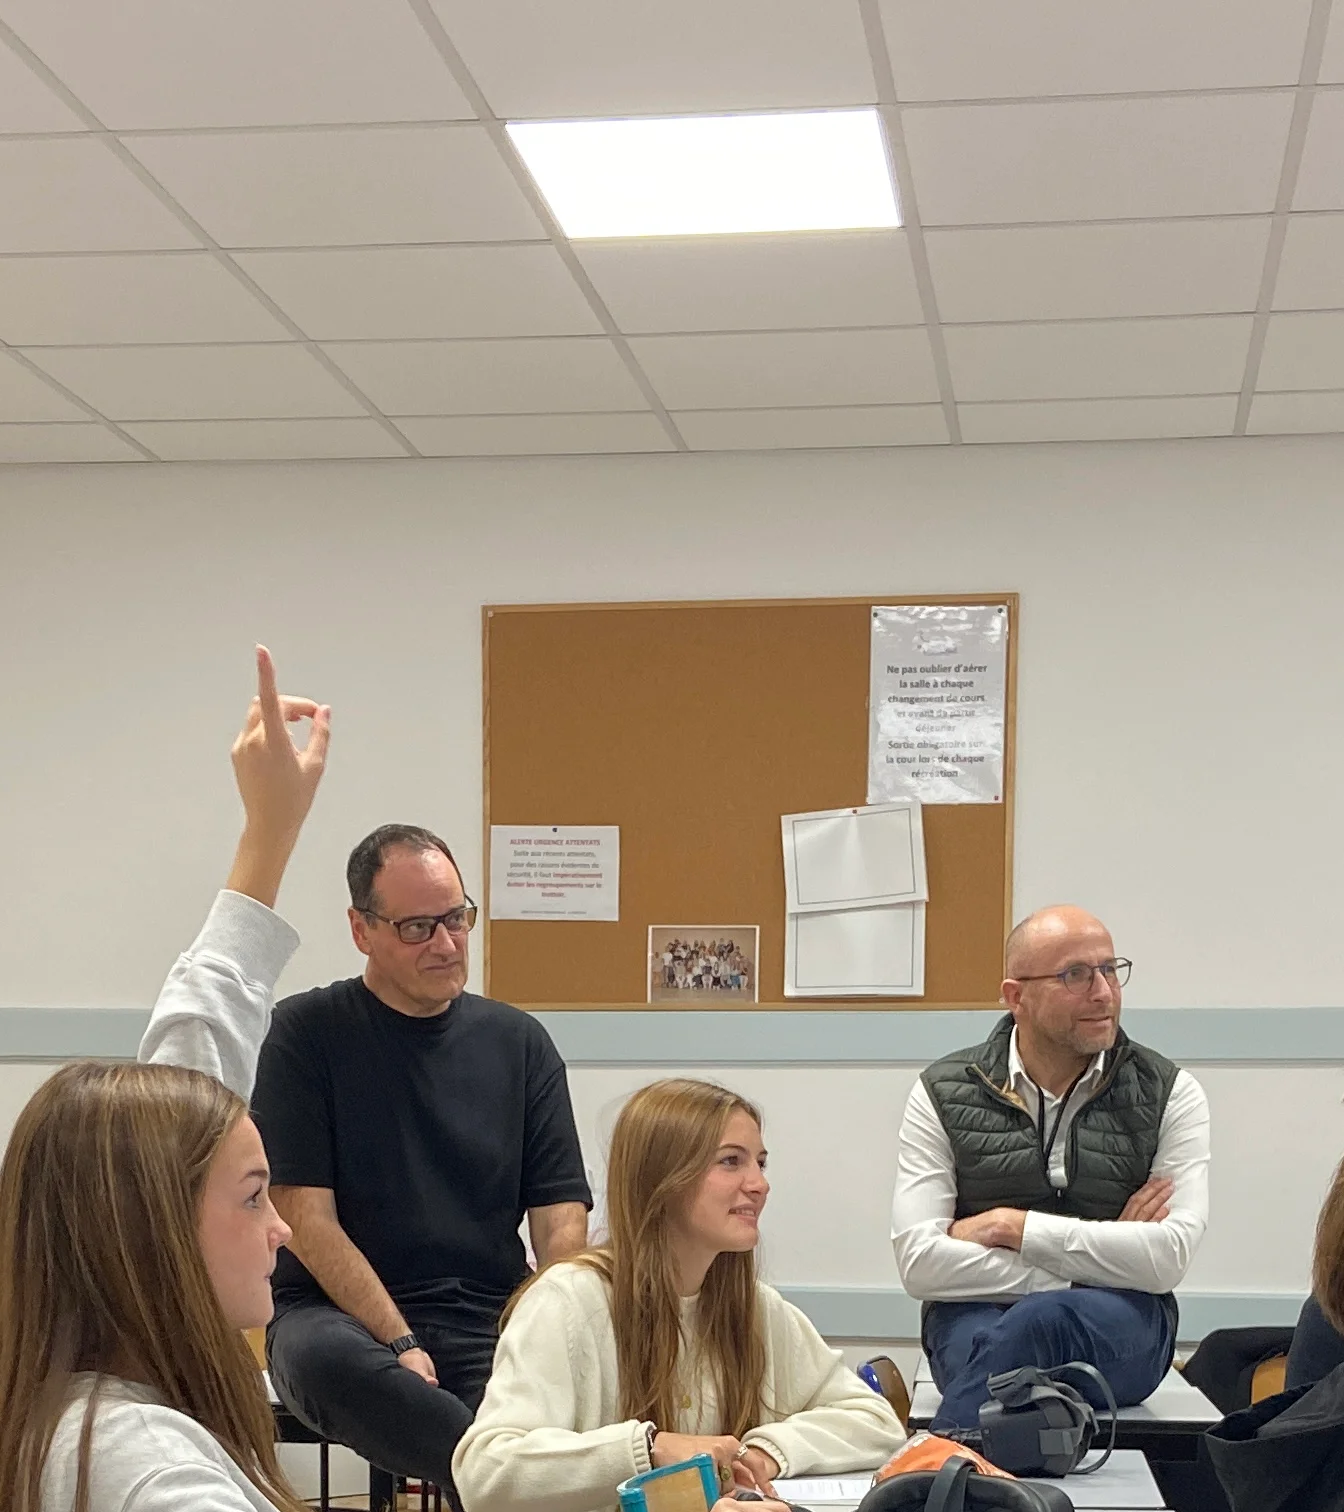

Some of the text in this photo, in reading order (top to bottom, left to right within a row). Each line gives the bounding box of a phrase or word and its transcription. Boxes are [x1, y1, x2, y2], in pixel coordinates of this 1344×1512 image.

[887, 665, 899, 674] Ne
[901, 667, 917, 675] pas
[919, 664, 951, 674] oublier
[899, 679, 974, 690] la salle à chaque
[888, 695, 944, 705] changement
[960, 694, 985, 702] cours
[886, 755, 894, 763] la
[938, 755, 949, 763] de
[951, 754, 985, 765] chaque
